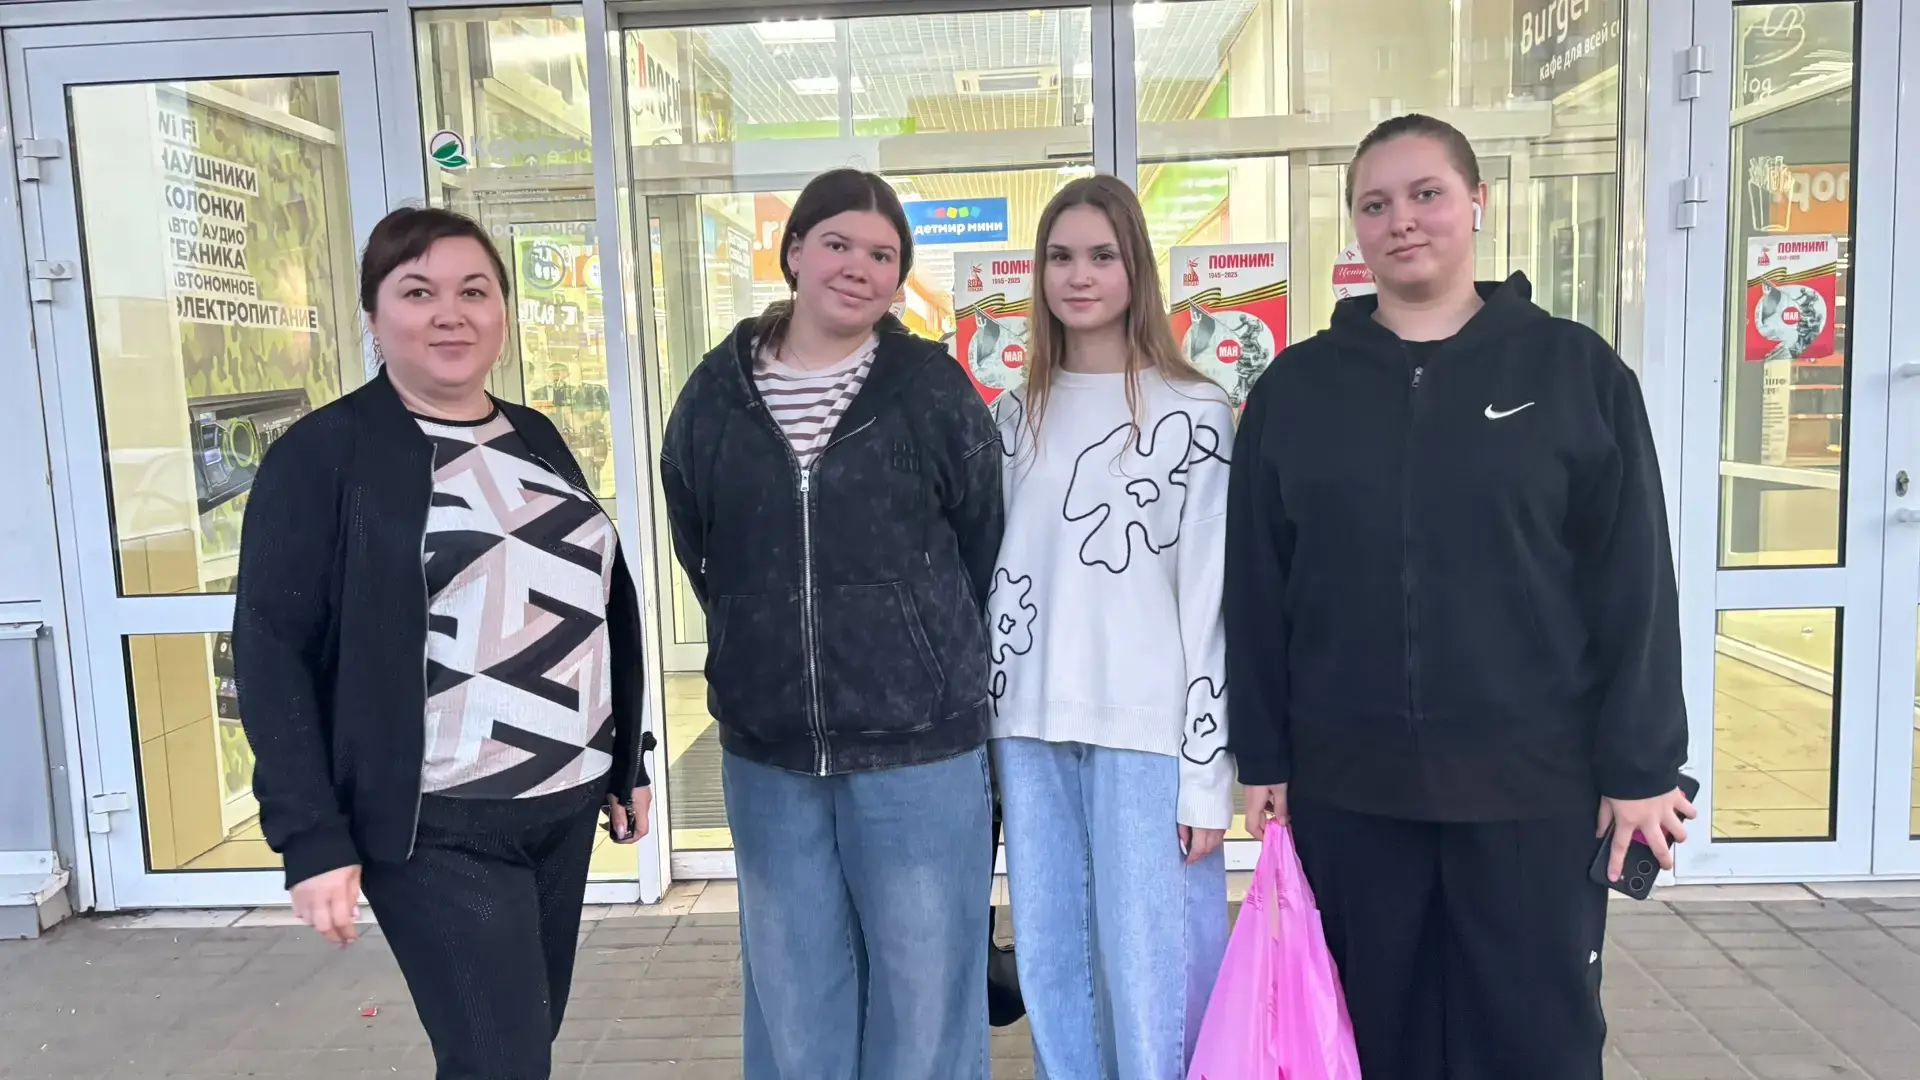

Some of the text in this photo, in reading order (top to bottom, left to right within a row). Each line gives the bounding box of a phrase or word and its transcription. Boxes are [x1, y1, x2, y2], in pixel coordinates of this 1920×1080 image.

[1540, 55, 1562, 81] кафе
[1563, 43, 1582, 71] для
[1584, 22, 1608, 55] всей
[182, 116, 197, 143] Fi
[202, 224, 245, 246] АУДИО
[914, 221, 1003, 236] детмир мини
[1777, 241, 1828, 254] ПОМНИМ!
[1208, 253, 1275, 269] ПОМНИМ!
[176, 297, 317, 329] ЭЛЕКТРОПИТАНИЕ
[1783, 311, 1799, 321] МАЯ
[1004, 350, 1023, 362] МАЯ
[1219, 346, 1238, 357] МАЯ
